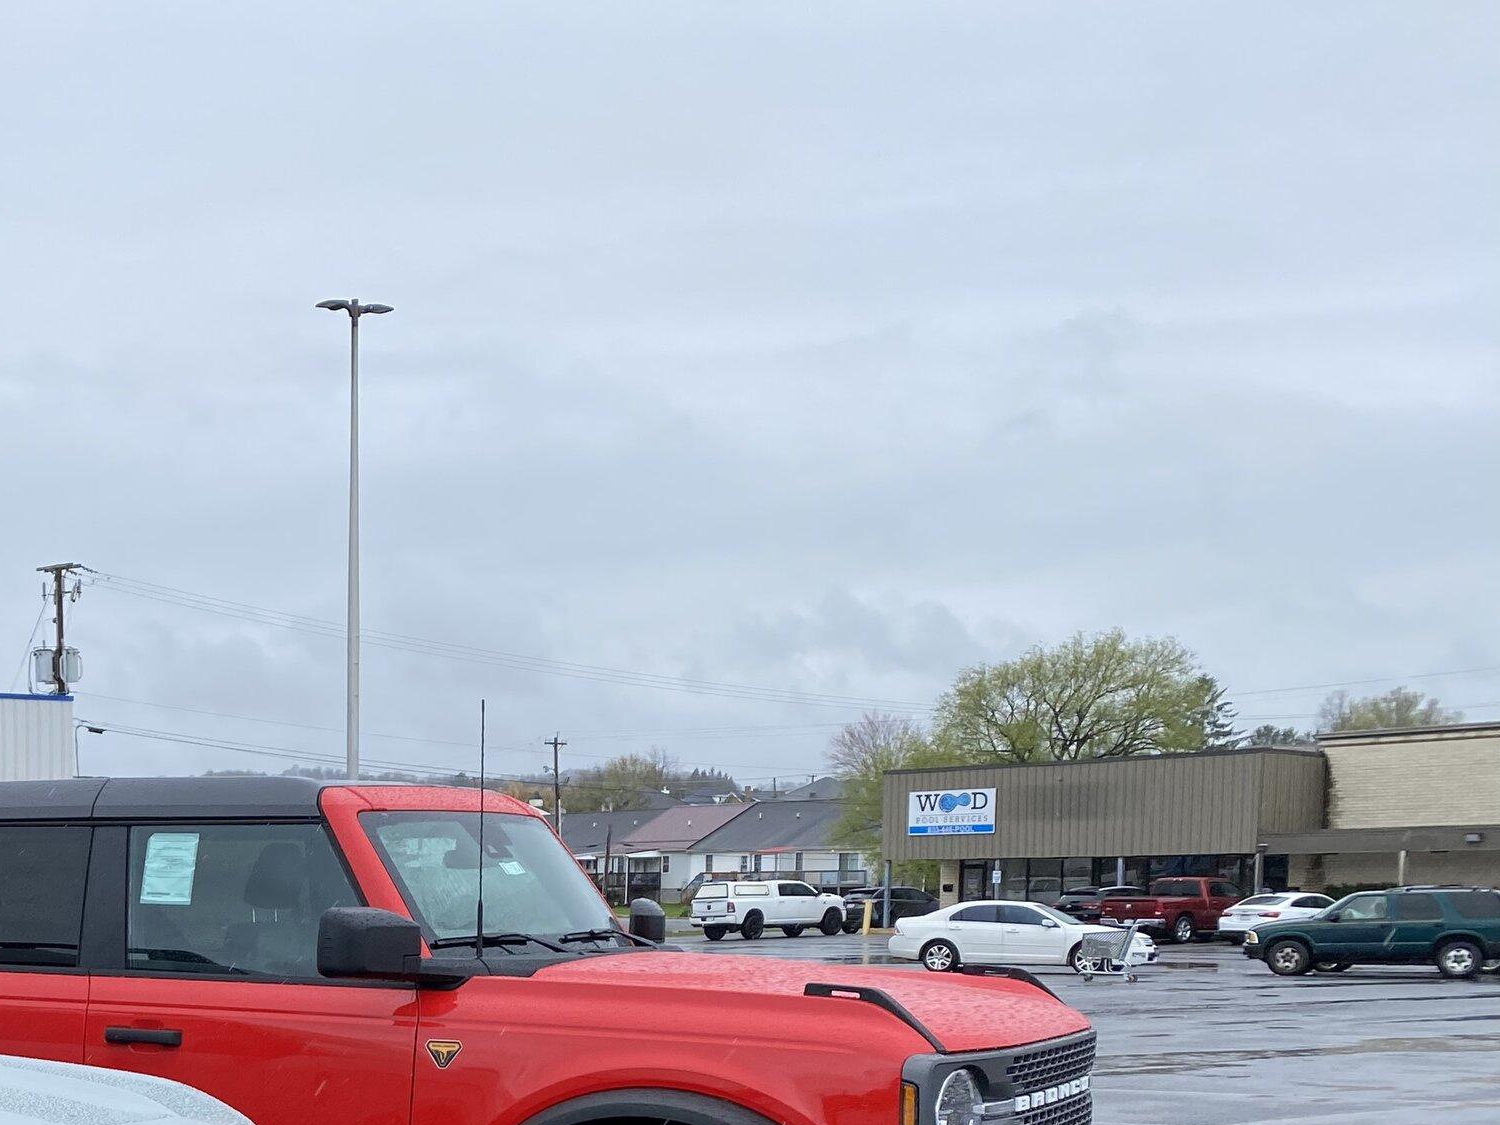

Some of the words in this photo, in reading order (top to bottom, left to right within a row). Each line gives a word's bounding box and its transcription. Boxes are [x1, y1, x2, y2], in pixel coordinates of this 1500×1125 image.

[916, 815, 941, 824] POOL
[943, 814, 989, 823] SERVICES
[1014, 1075, 1091, 1112] BRONCO
